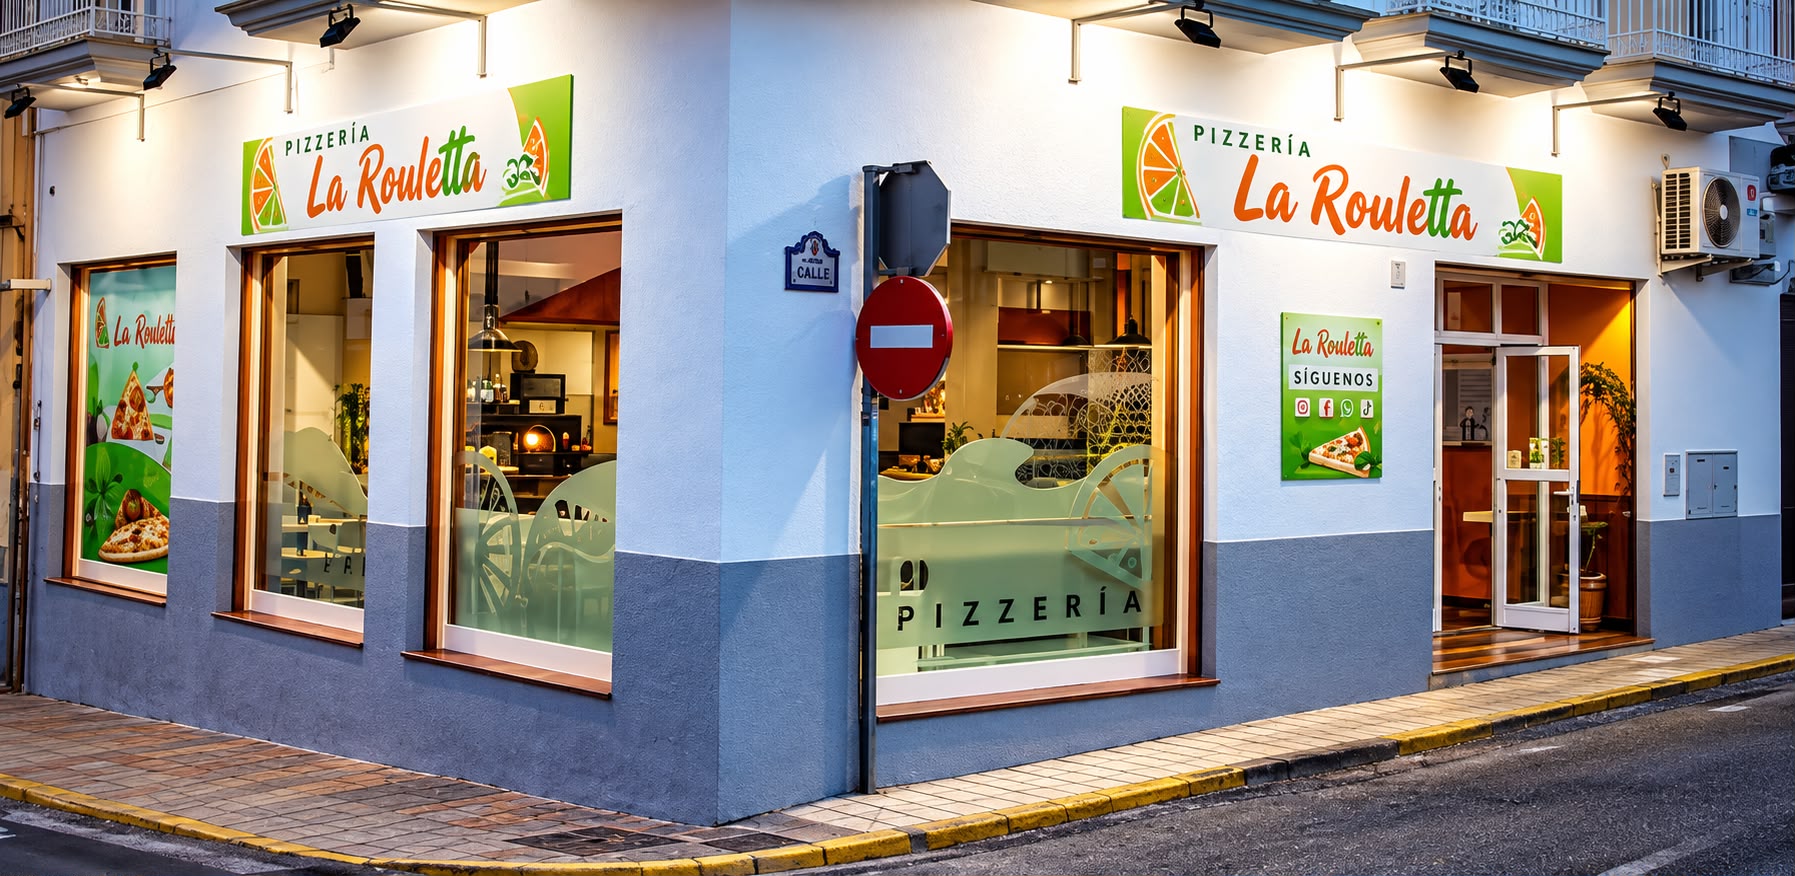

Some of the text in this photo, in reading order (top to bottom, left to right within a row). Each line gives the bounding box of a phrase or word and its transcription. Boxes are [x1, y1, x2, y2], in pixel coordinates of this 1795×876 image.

[285, 121, 370, 156] PIZZERÍA
[1193, 124, 1311, 158] PIZZERÍA
[306, 125, 487, 219] La Rouletta
[1233, 153, 1478, 241] La Rouletta
[797, 266, 830, 280] CALLE
[113, 315, 131, 347] La
[1291, 327, 1374, 359] La Rouletta
[1293, 366, 1373, 387] SÍGUENOS
[897, 585, 1142, 632] PIZZERÍA
